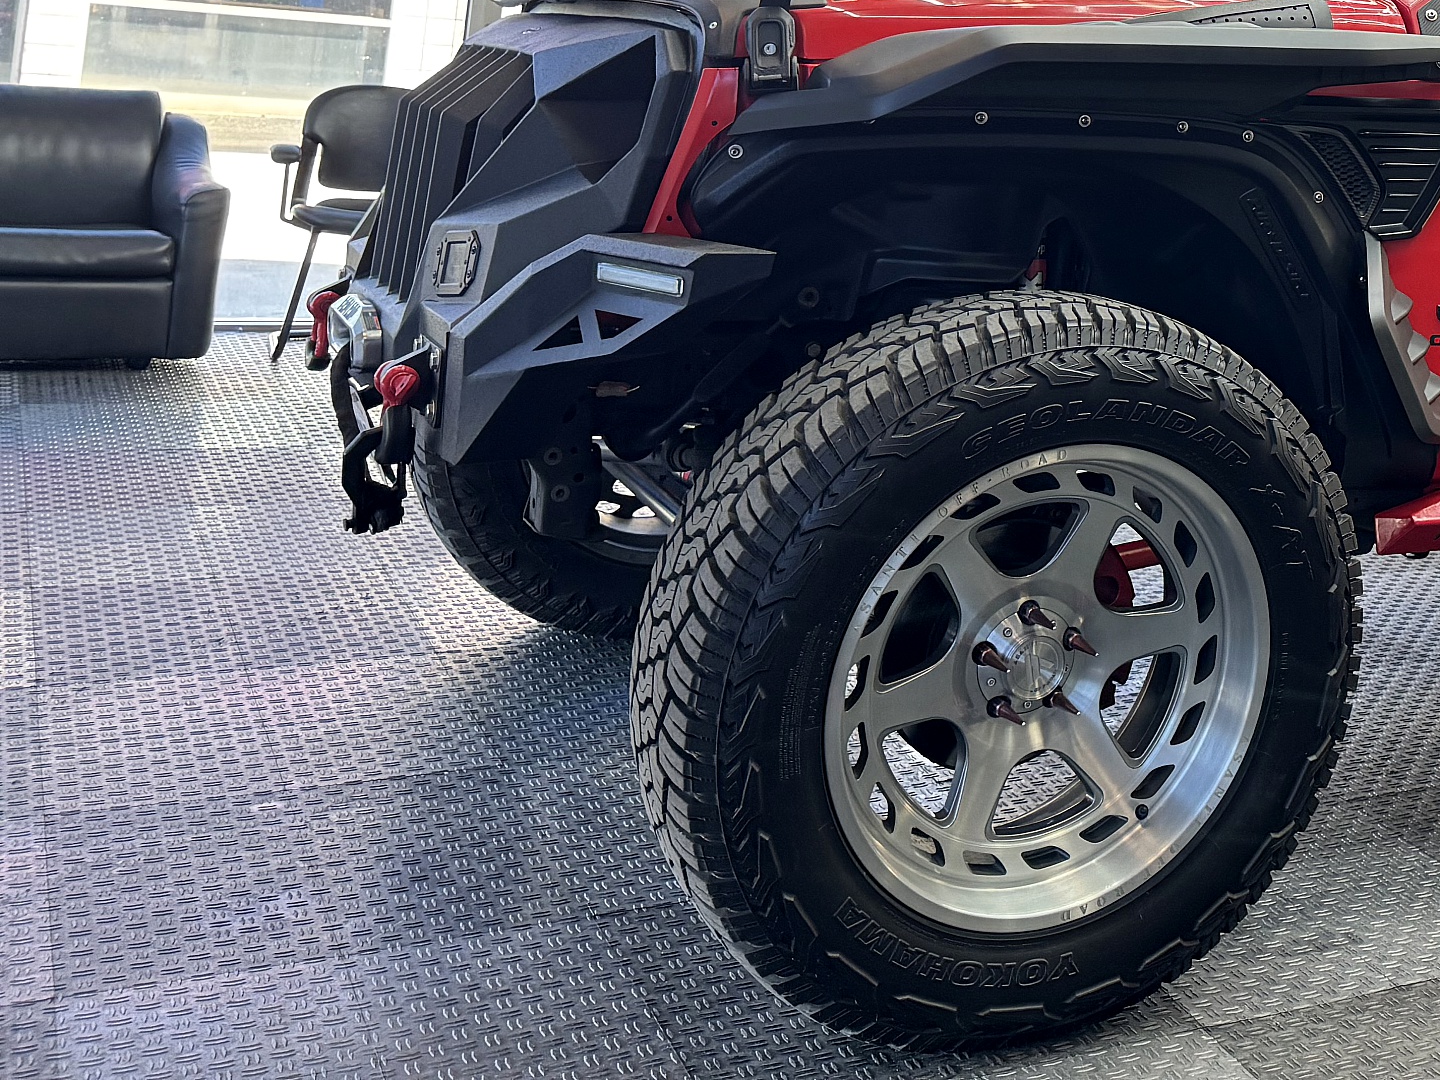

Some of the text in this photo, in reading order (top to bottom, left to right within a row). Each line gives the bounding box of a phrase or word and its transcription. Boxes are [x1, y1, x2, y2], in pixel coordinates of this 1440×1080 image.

[961, 399, 1251, 467] GEOLANDAR
[852, 448, 1069, 632] ASANTI OFF-ROAD
[833, 896, 1080, 988] YOKOHAMA
